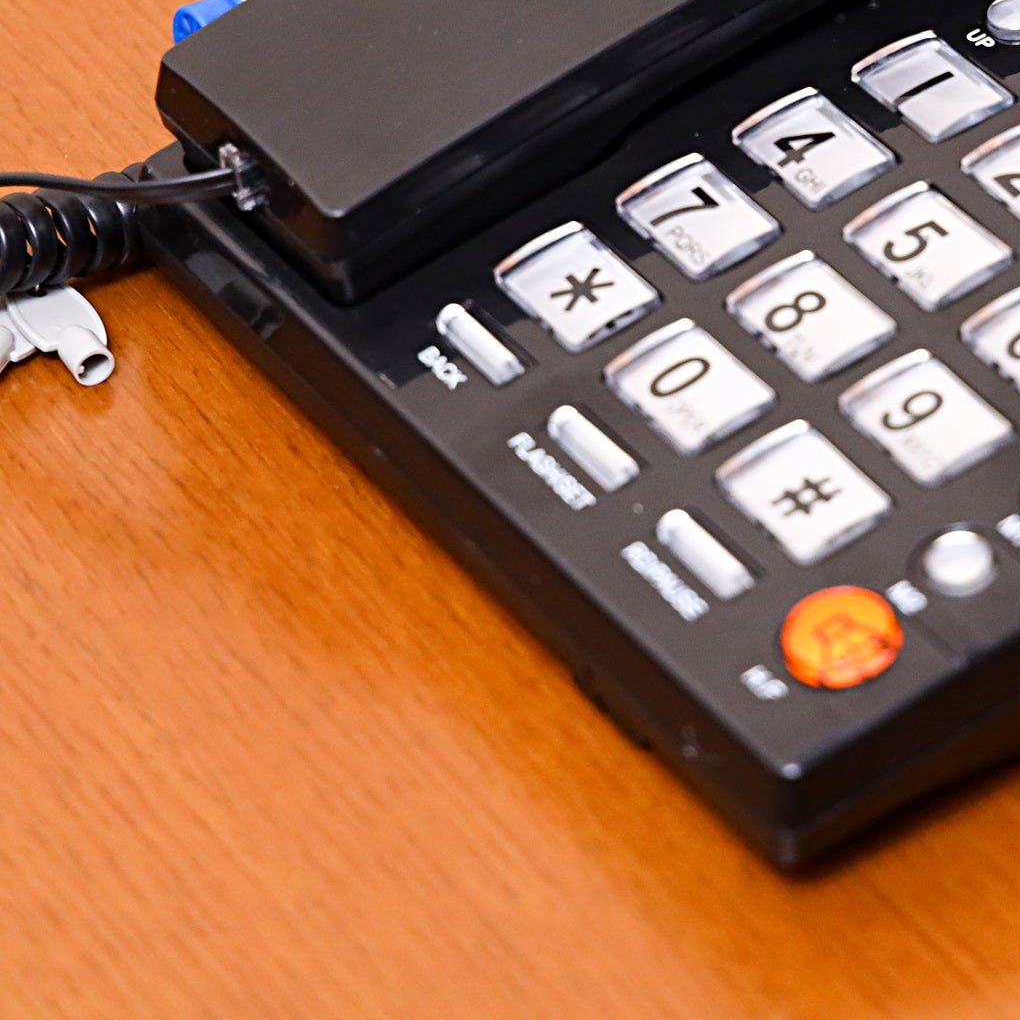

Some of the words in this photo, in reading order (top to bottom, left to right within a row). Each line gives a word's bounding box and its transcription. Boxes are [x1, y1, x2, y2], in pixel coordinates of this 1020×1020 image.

[965, 28, 996, 49] UP
[773, 131, 836, 168] 4
[650, 186, 719, 227] 7
[883, 220, 949, 263] 5
[764, 291, 826, 332] 8
[416, 345, 469, 391] BACK
[650, 357, 710, 397] 0
[881, 390, 943, 430] 9
